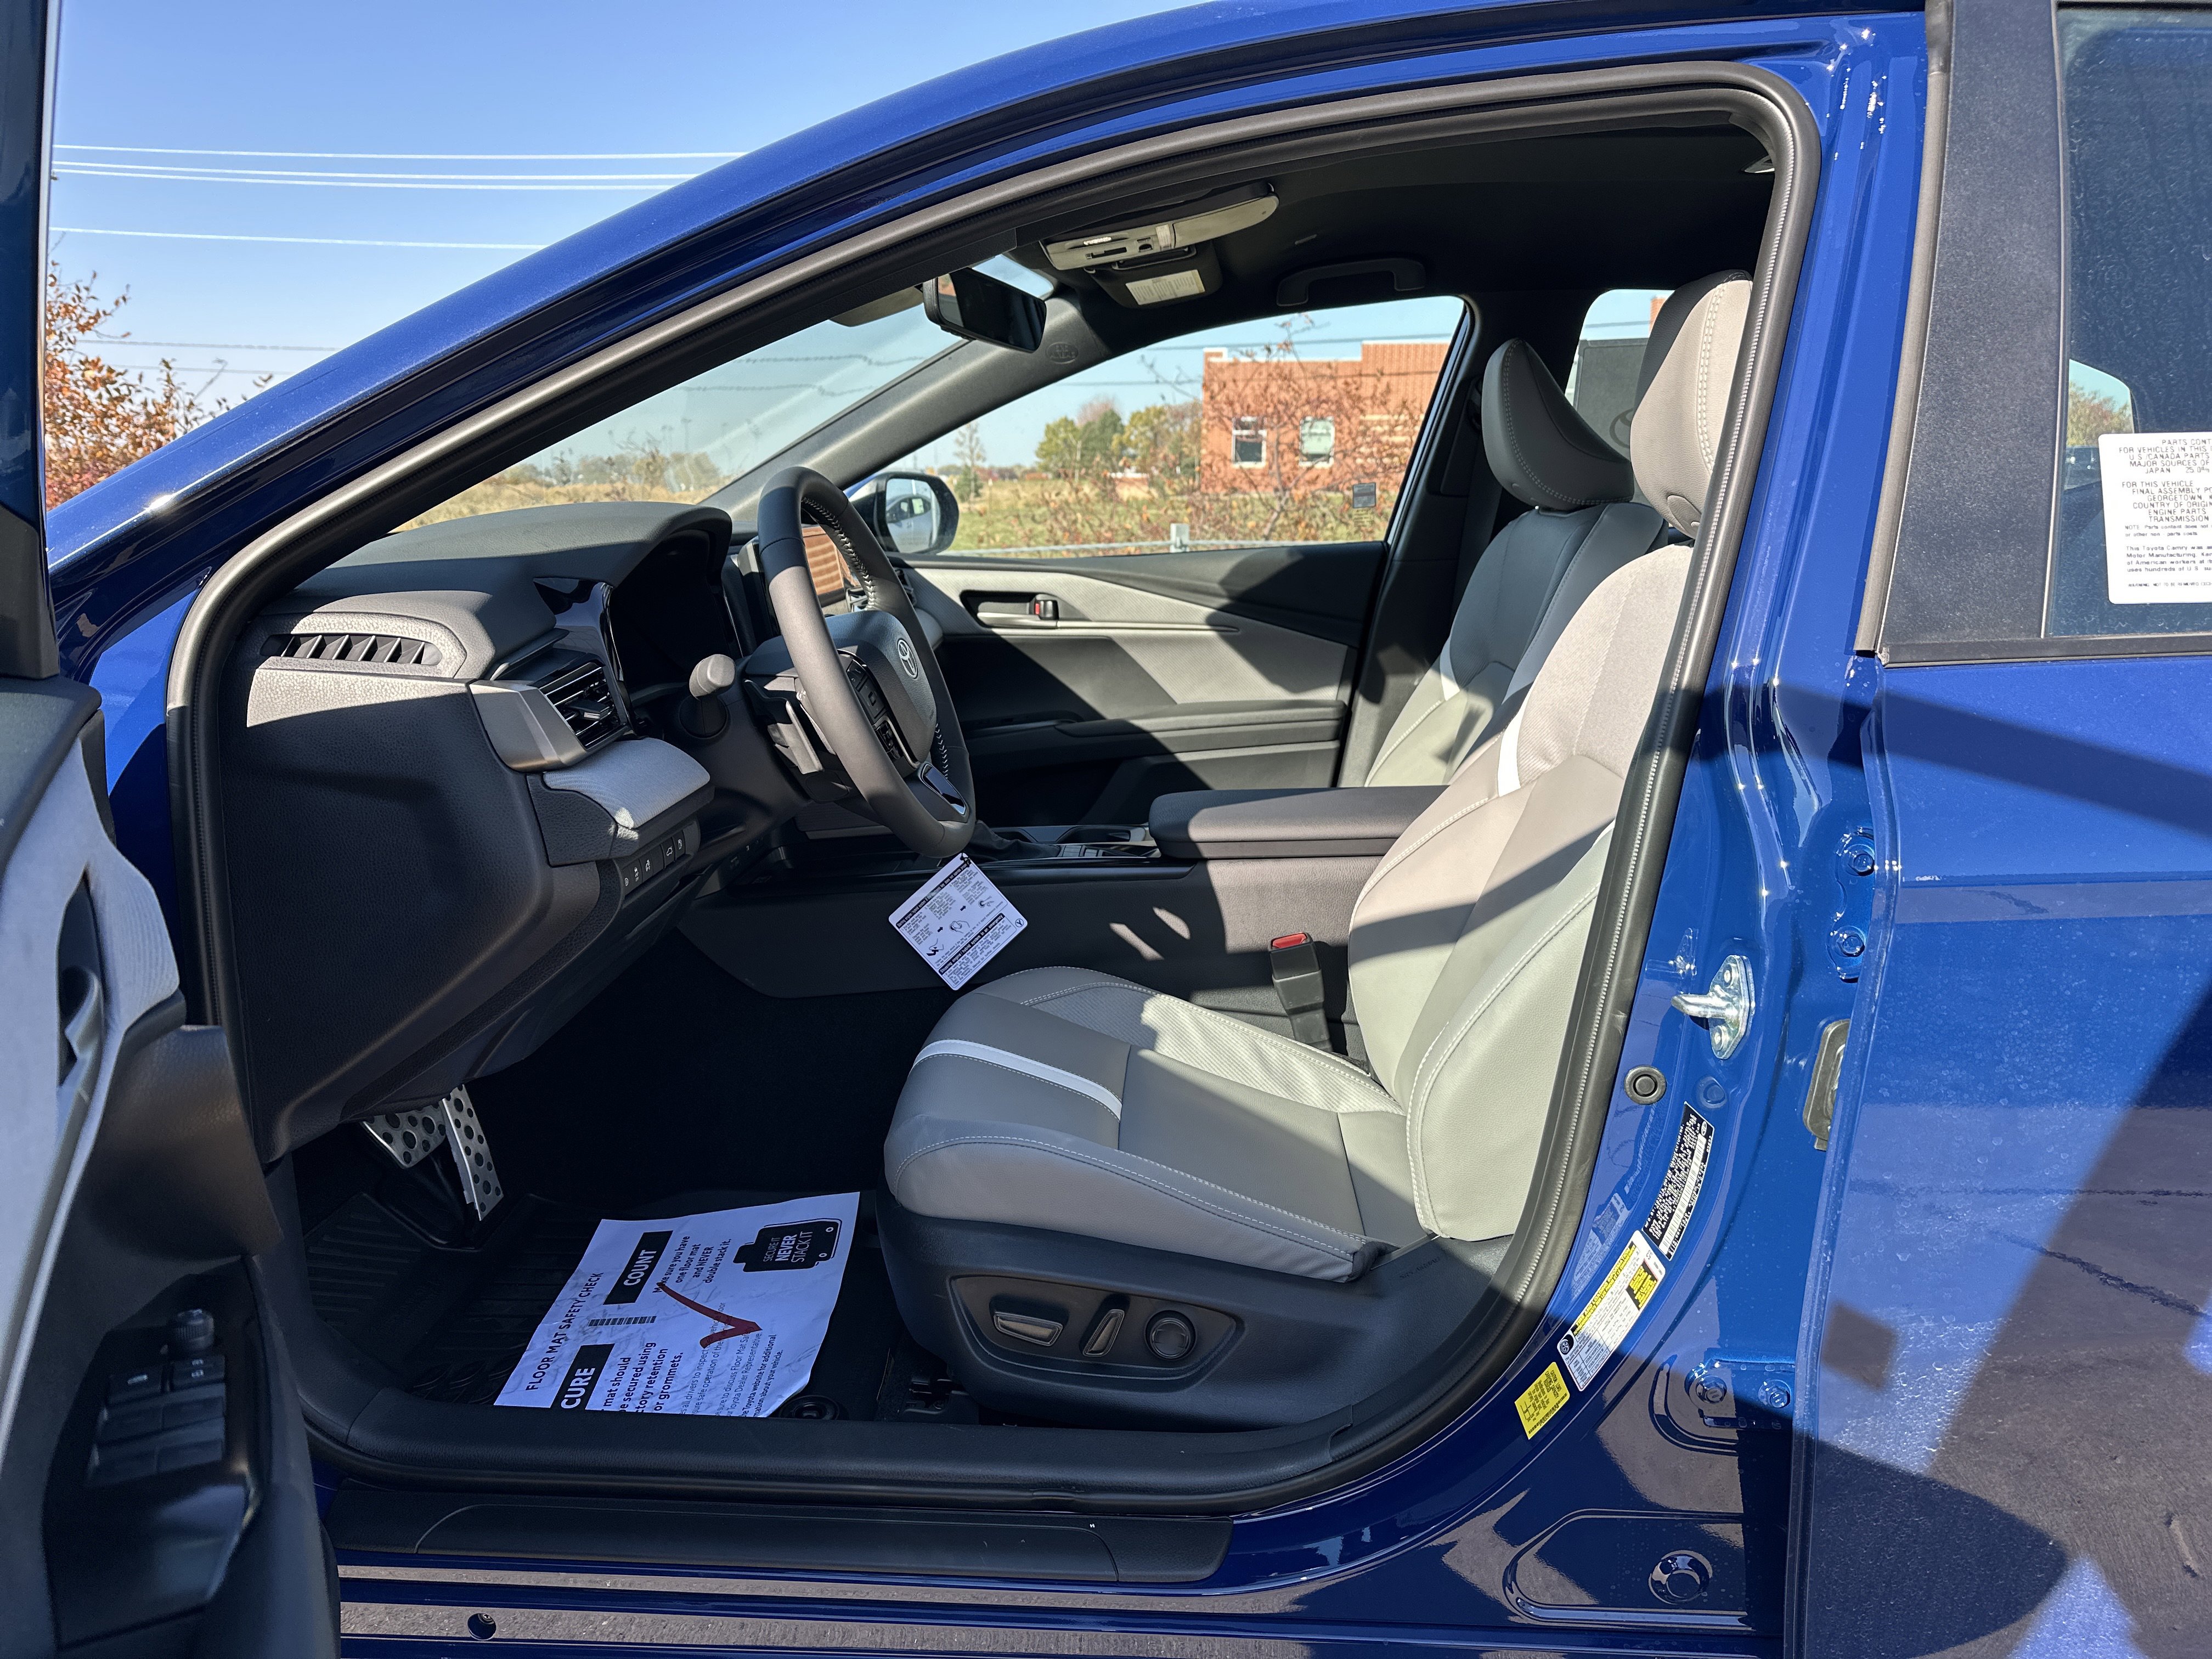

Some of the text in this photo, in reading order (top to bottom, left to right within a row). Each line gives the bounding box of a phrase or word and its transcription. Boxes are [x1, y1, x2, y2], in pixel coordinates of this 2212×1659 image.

[939, 961, 953, 974] Stopping
[951, 953, 962, 963] engine
[961, 943, 972, 953] hybrid
[652, 1236, 690, 1293] Mke sure you have
[675, 1244, 701, 1283] one floor mat
[693, 1246, 714, 1278] and NEVER
[703, 1262, 720, 1283] double
[715, 1246, 728, 1262] stack
[763, 1243, 779, 1262] SECURE
[775, 1234, 797, 1261] NEVER
[791, 1239, 811, 1262] STACK
[624, 1250, 657, 1285] COUNT
[1592, 1280, 1608, 1305] LOADING
[1606, 1247, 1631, 1283] INFORMATION
[526, 1272, 603, 1391] FLOOR MAT SAFETY CHECK
[736, 1344, 746, 1354] Mat
[603, 1357, 631, 1406] mat should
[623, 1367, 644, 1402] secured
[638, 1342, 656, 1365] using
[646, 1348, 668, 1389] retention
[654, 1352, 683, 1411] or grommets.
[684, 1379, 698, 1400] drivers
[696, 1347, 708, 1372] inspect
[698, 1389, 707, 1401] safe
[703, 1361, 716, 1389] operation
[724, 1372, 737, 1391] discuss
[731, 1355, 743, 1370] Floor
[742, 1392, 756, 1412] Toyota
[752, 1371, 764, 1392] website
[761, 1334, 777, 1363] additional
[561, 1368, 596, 1409] CURE
[727, 1393, 741, 1411] Toyota
[735, 1374, 747, 1392] Dealer
[761, 1381, 771, 1400] about
[768, 1369, 777, 1383] your
